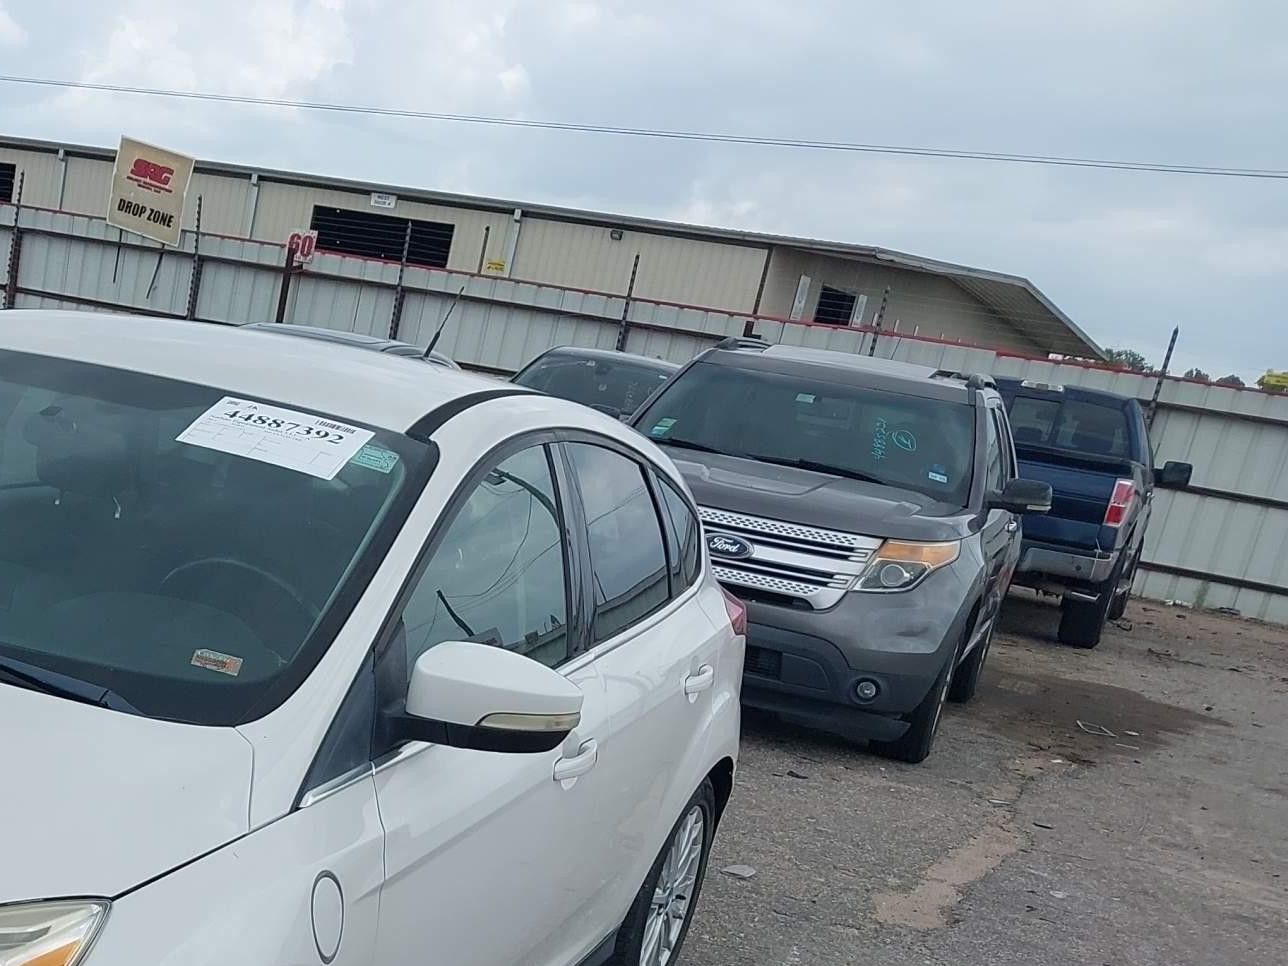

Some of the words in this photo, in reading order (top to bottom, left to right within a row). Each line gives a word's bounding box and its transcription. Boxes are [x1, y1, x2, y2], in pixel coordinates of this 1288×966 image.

[117, 198, 147, 219] DROP
[146, 207, 174, 228] ZONE
[289, 233, 314, 258] 60
[223, 409, 344, 445] 44887392
[709, 536, 740, 552] Ford
